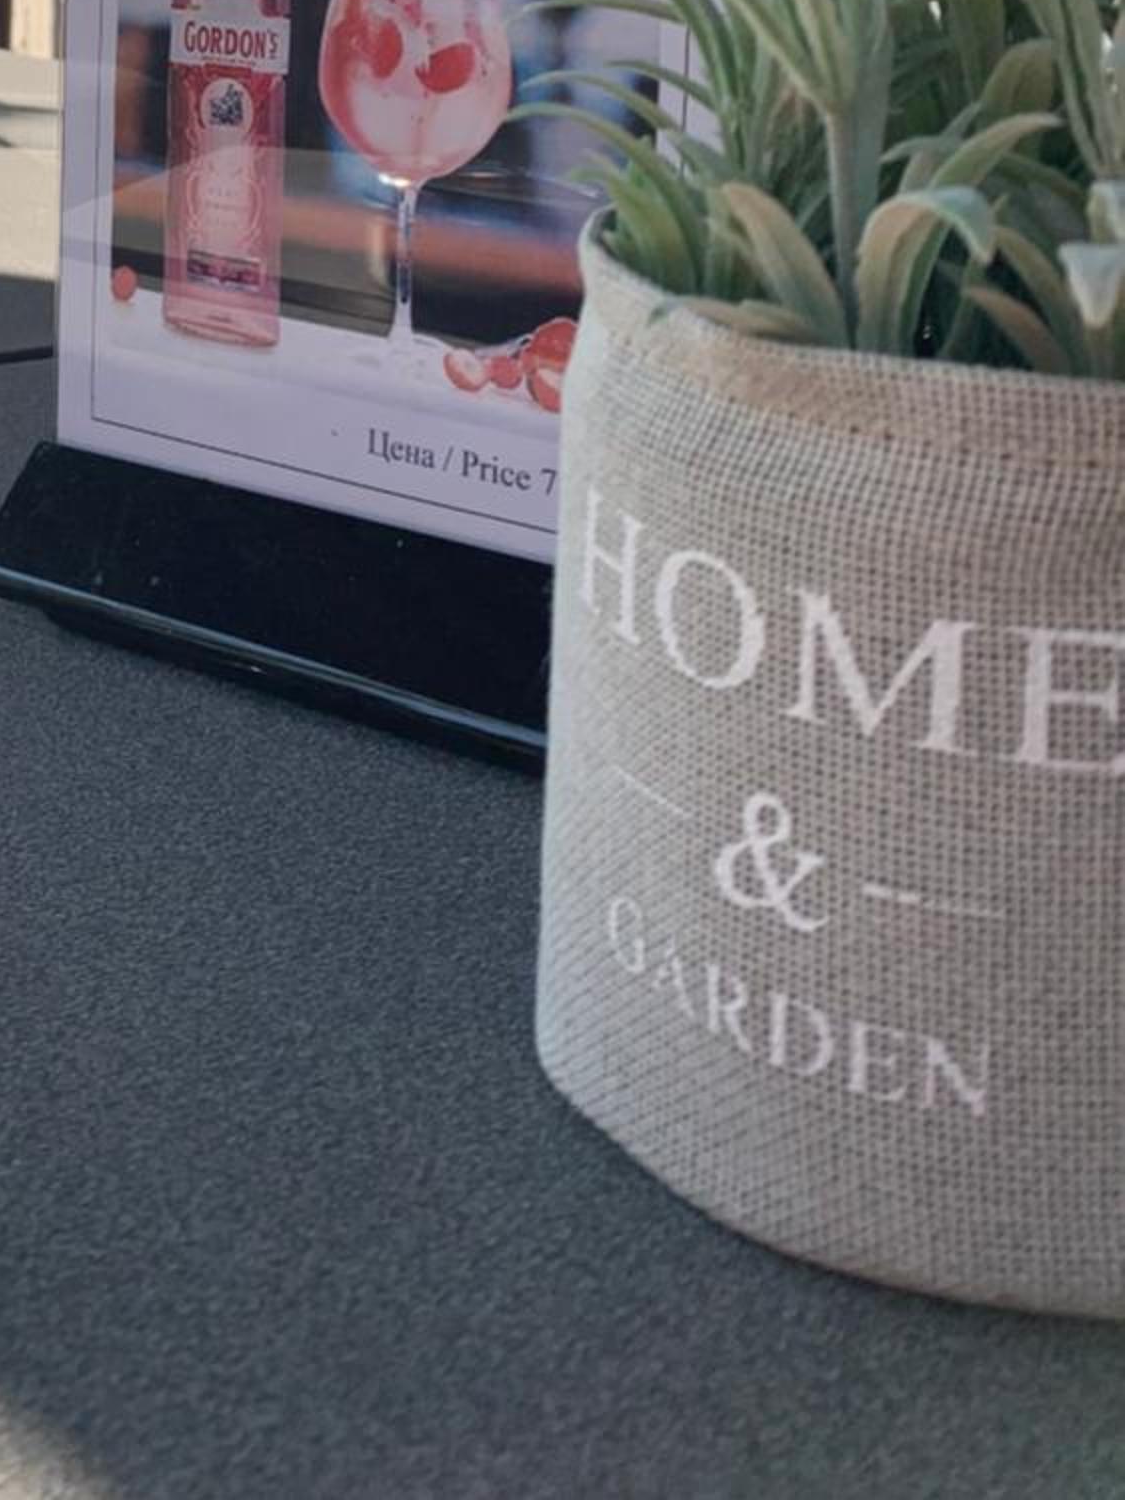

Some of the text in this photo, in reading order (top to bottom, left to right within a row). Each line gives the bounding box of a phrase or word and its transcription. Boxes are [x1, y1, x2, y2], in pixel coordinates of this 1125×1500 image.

[184, 20, 279, 60] GORDON'S
[368, 428, 435, 470] Цена
[461, 449, 532, 491] Price
[576, 486, 1125, 775] HOME
[713, 792, 831, 933] &
[609, 897, 992, 1116] GARDEN
